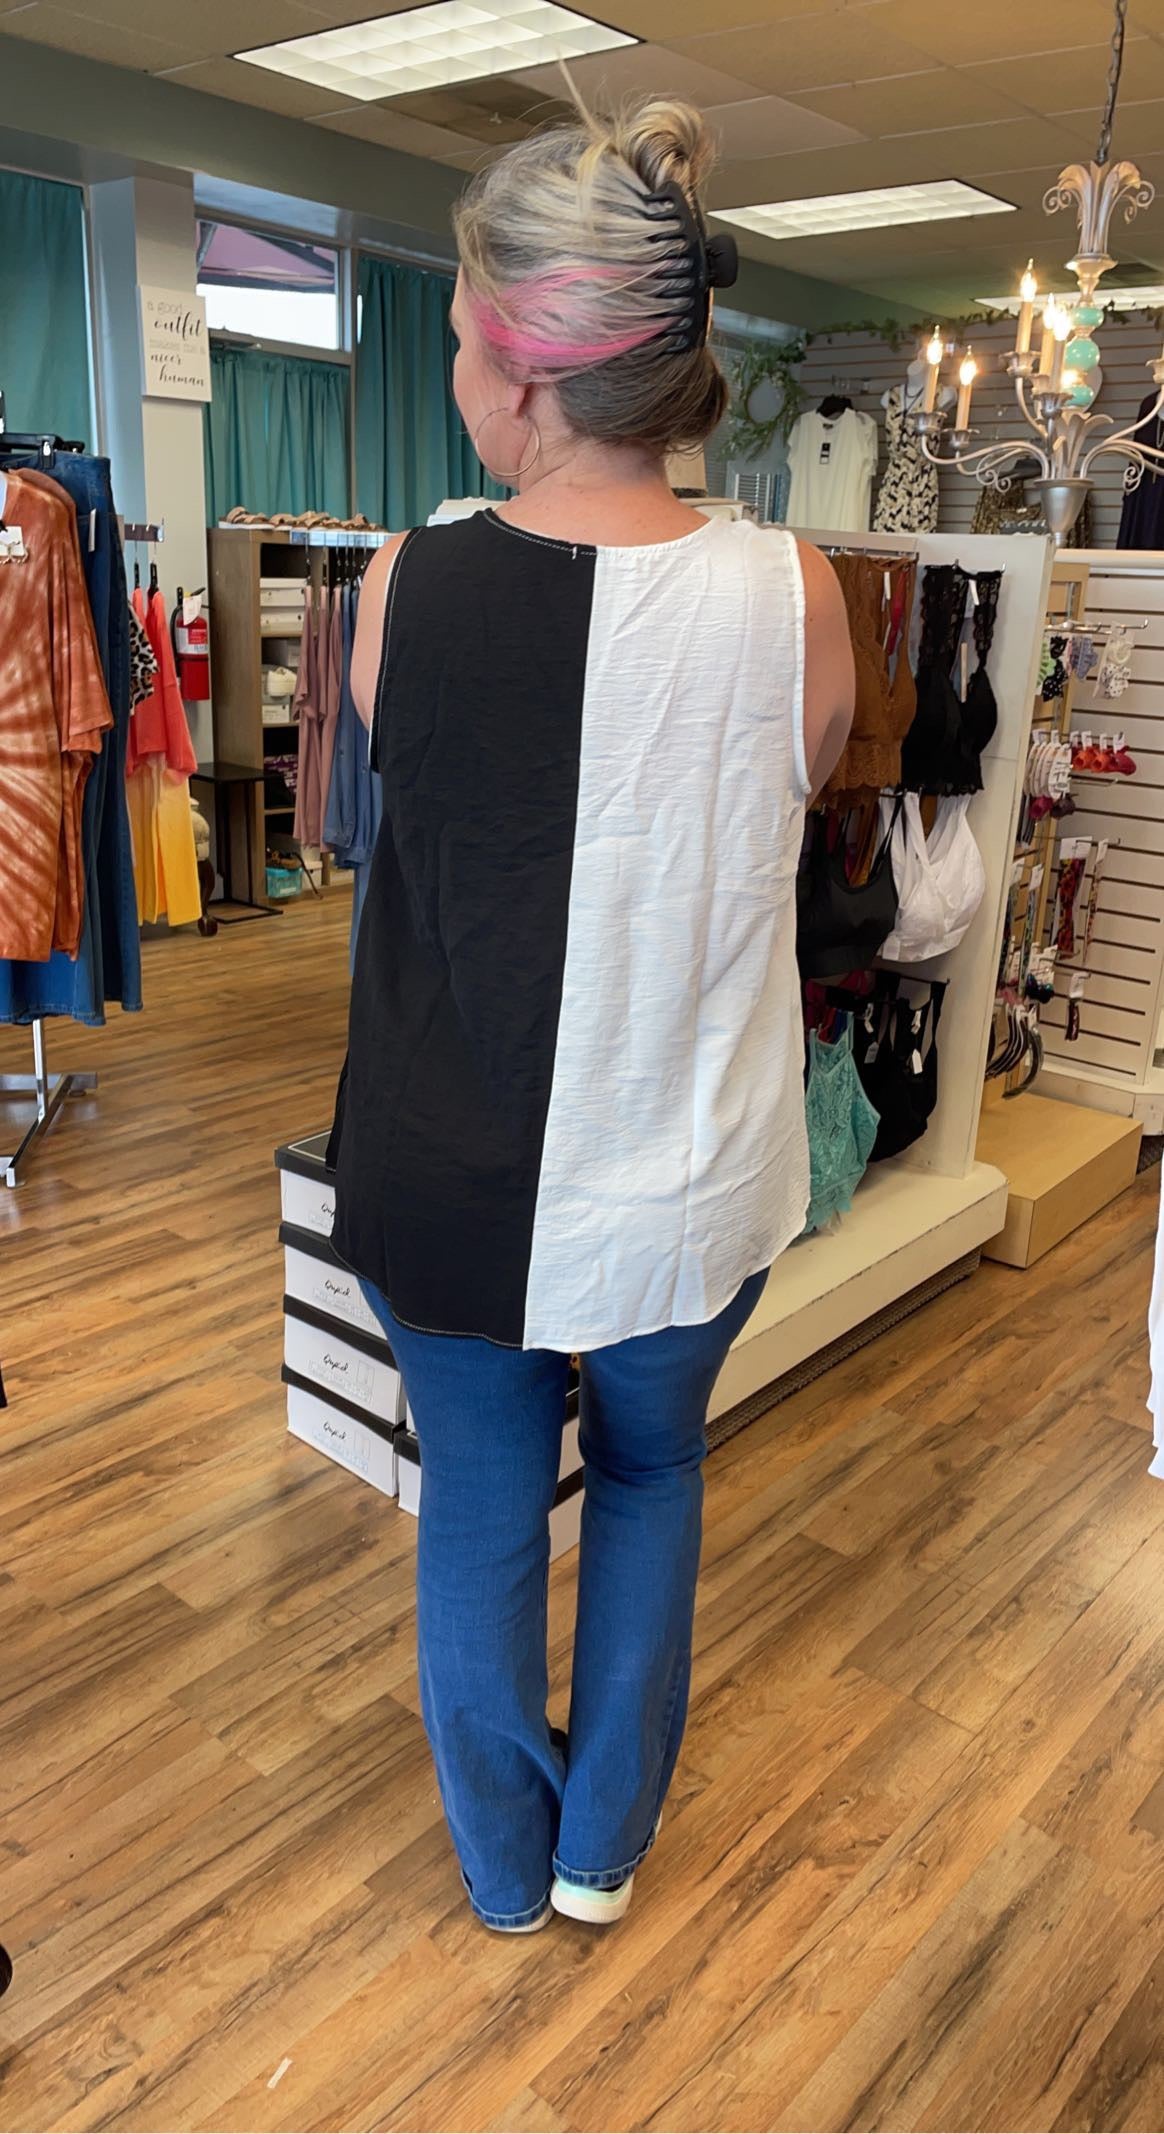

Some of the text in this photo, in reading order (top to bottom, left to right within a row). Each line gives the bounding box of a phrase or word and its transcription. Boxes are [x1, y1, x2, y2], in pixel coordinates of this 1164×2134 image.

[154, 311, 200, 341] outfit
[151, 354, 181, 365] nicer
[159, 364, 204, 387] human
[321, 1203, 335, 1217] Qup
